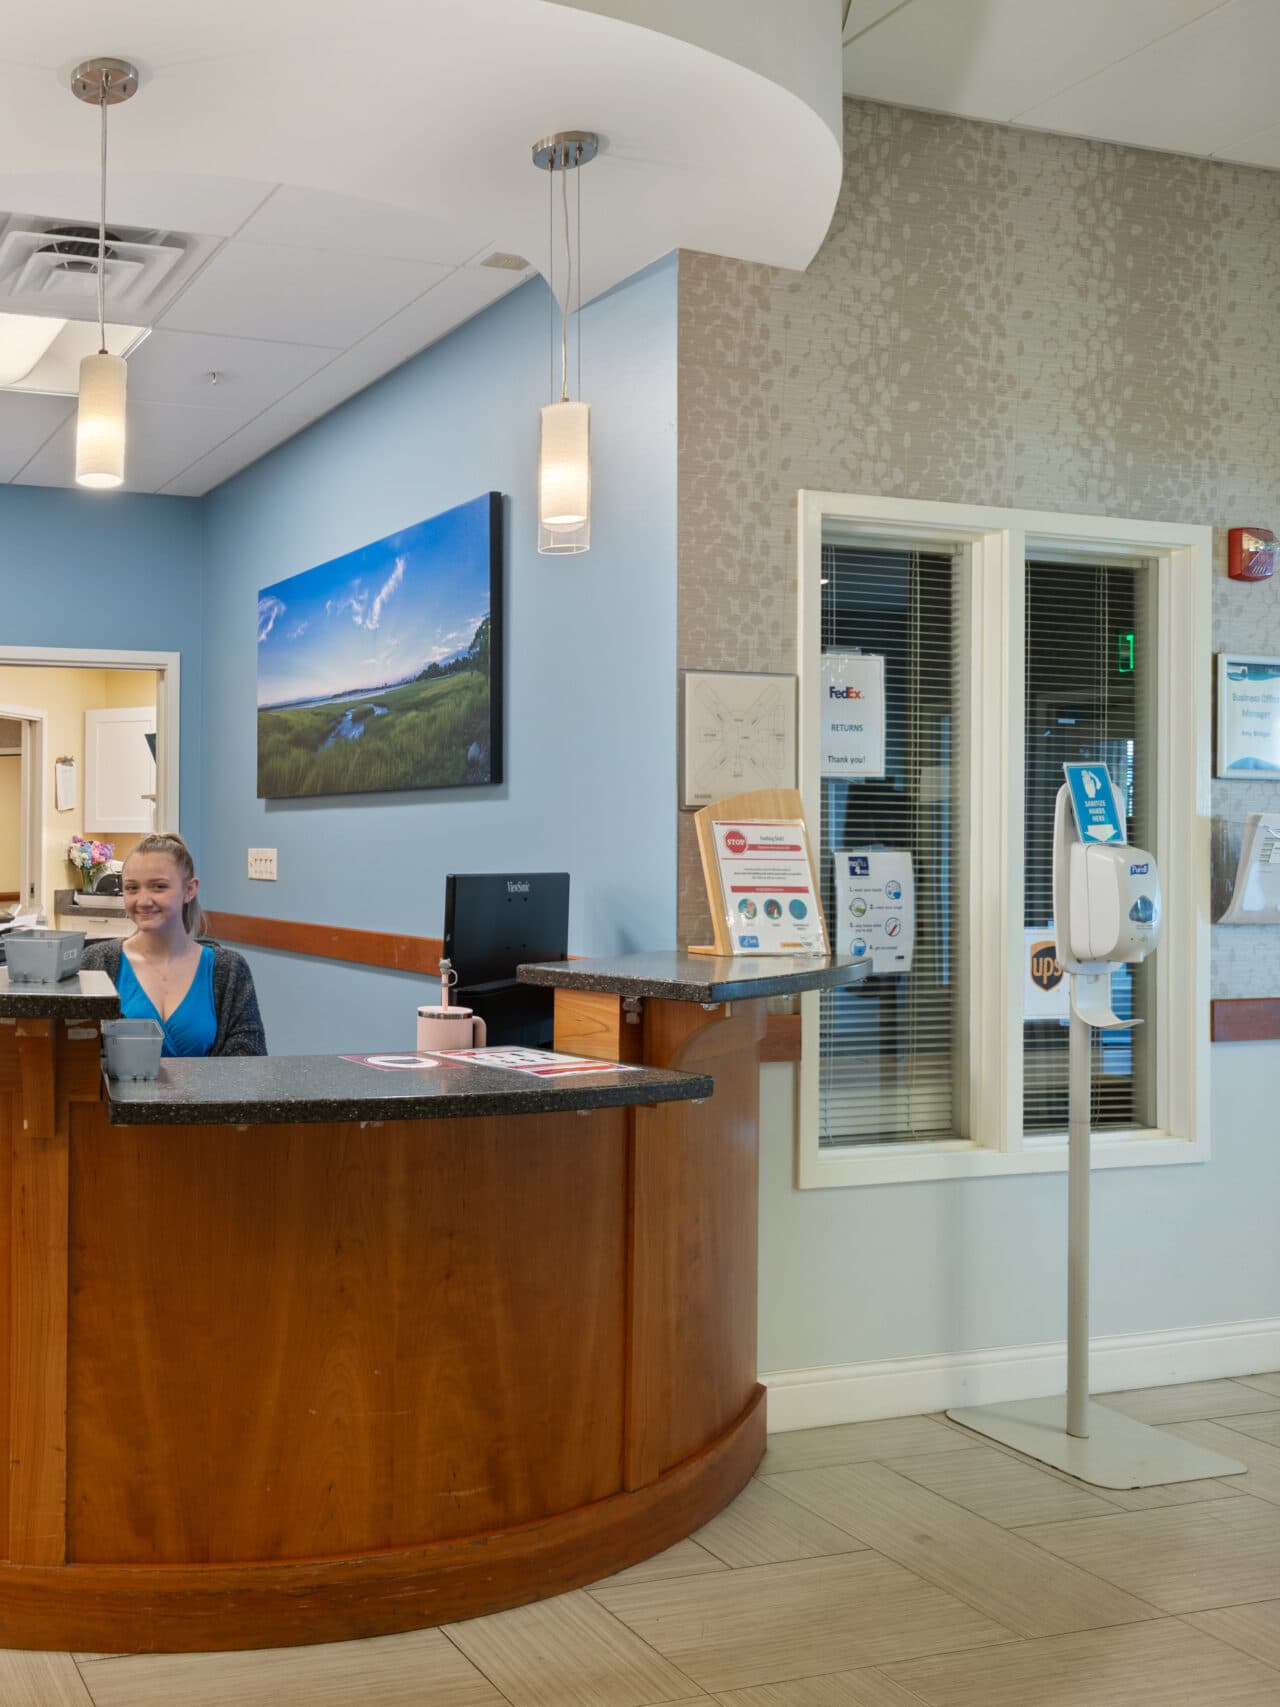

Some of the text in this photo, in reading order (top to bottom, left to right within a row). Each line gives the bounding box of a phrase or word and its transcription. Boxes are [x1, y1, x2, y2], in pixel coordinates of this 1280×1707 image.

[829, 686, 862, 699] FedEx
[831, 723, 864, 732] RETURNS
[828, 755, 866, 765] Thank you!
[727, 838, 745, 847] STOP
[507, 880, 530, 893] ViewSonic
[1032, 957, 1064, 985] ups
